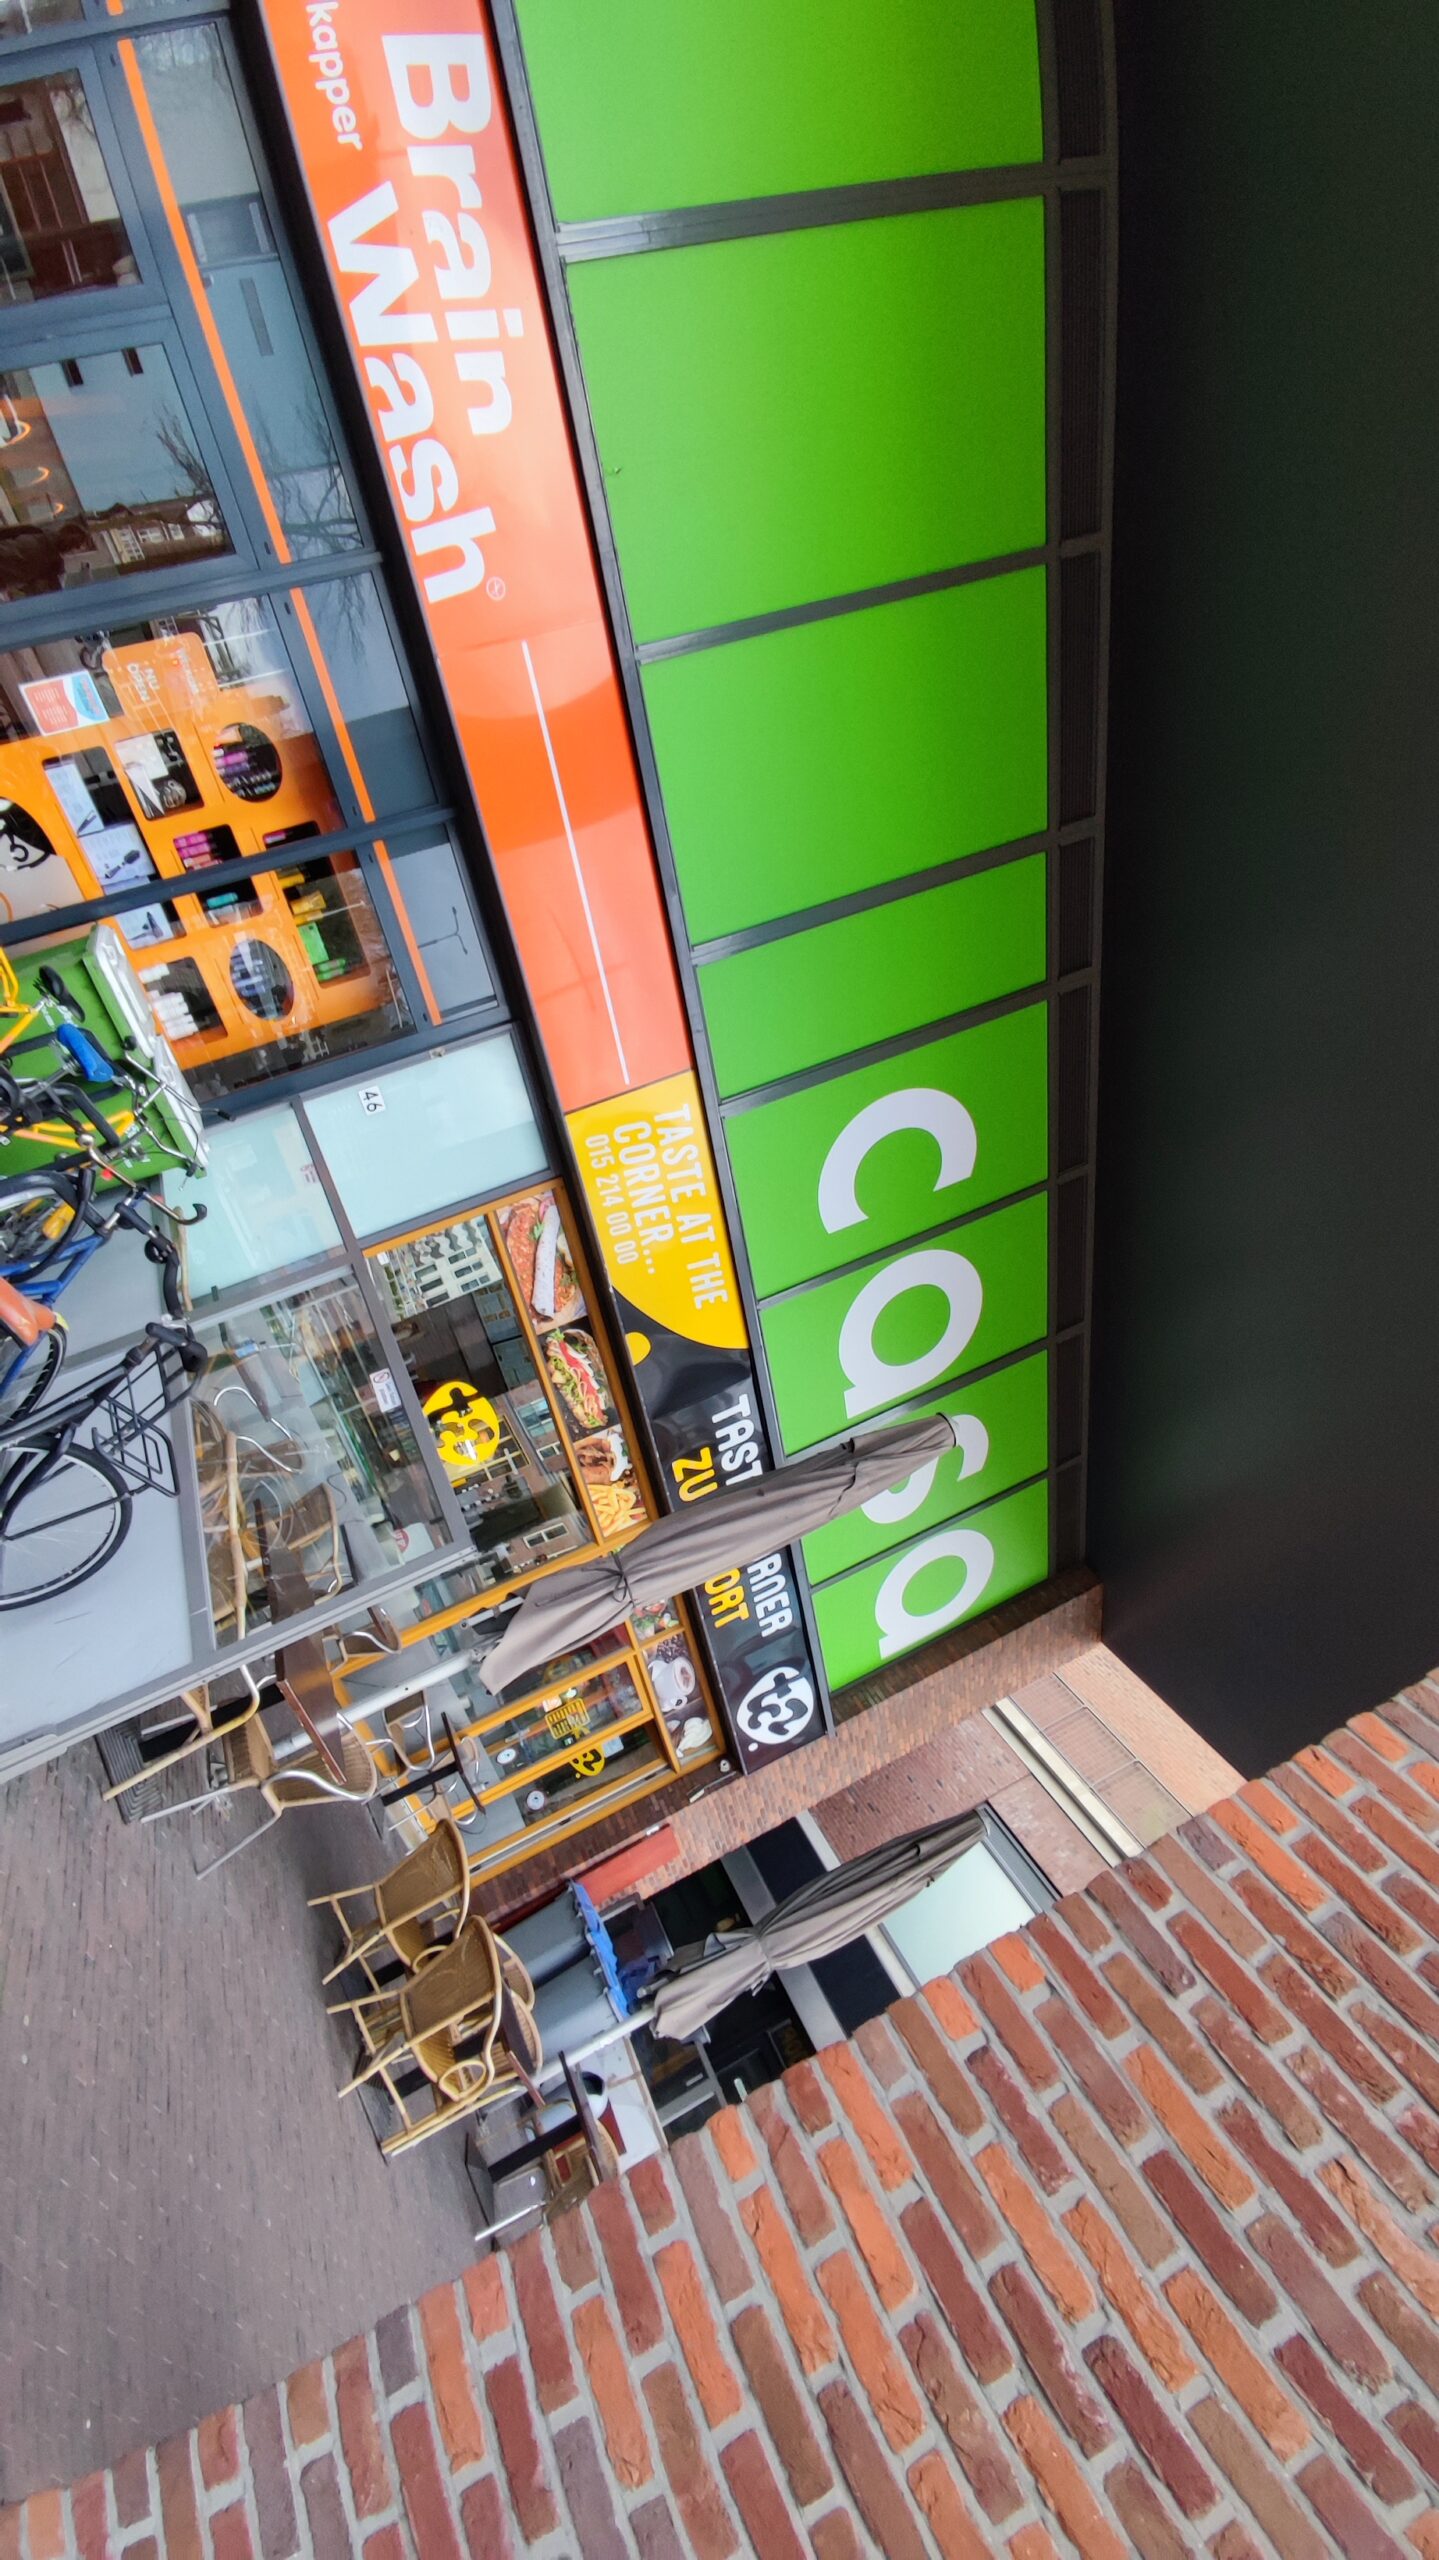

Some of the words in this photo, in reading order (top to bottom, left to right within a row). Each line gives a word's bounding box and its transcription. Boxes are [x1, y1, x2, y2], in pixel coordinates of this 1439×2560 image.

[306, 2, 363, 151] kapper
[381, 33, 524, 435] Brain
[363, 1092, 383, 1112] 46
[584, 1134, 612, 1169] 015
[653, 1103, 706, 1202] TASTE
[595, 1173, 622, 1207] 214
[613, 1120, 674, 1274] CORNER...
[605, 1210, 632, 1233] 00
[674, 1206, 716, 1245] AT
[613, 1240, 639, 1264] 00
[685, 1251, 728, 1309] THE
